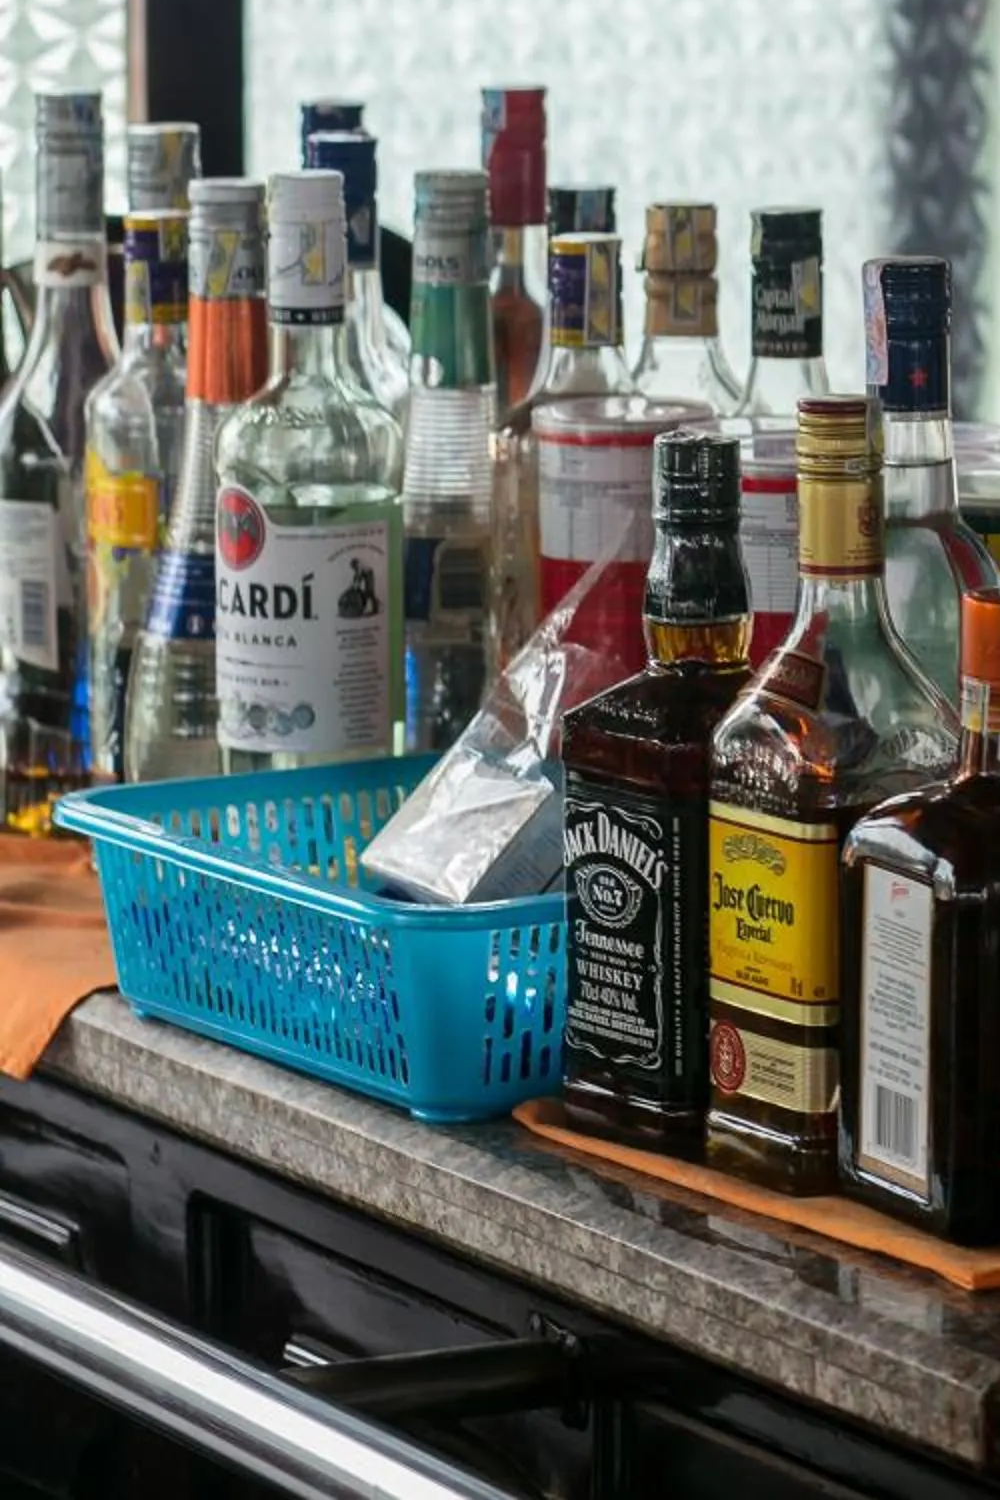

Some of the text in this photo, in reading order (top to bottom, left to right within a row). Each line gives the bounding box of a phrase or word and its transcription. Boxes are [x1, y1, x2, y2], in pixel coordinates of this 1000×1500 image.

[755, 283, 795, 311] Captai
[235, 632, 298, 649] BLANCA
[563, 821, 597, 867] JACK
[712, 871, 795, 926] Jose Cuervo
[575, 918, 645, 959] Tennessee
[575, 957, 644, 991] WHISKEY
